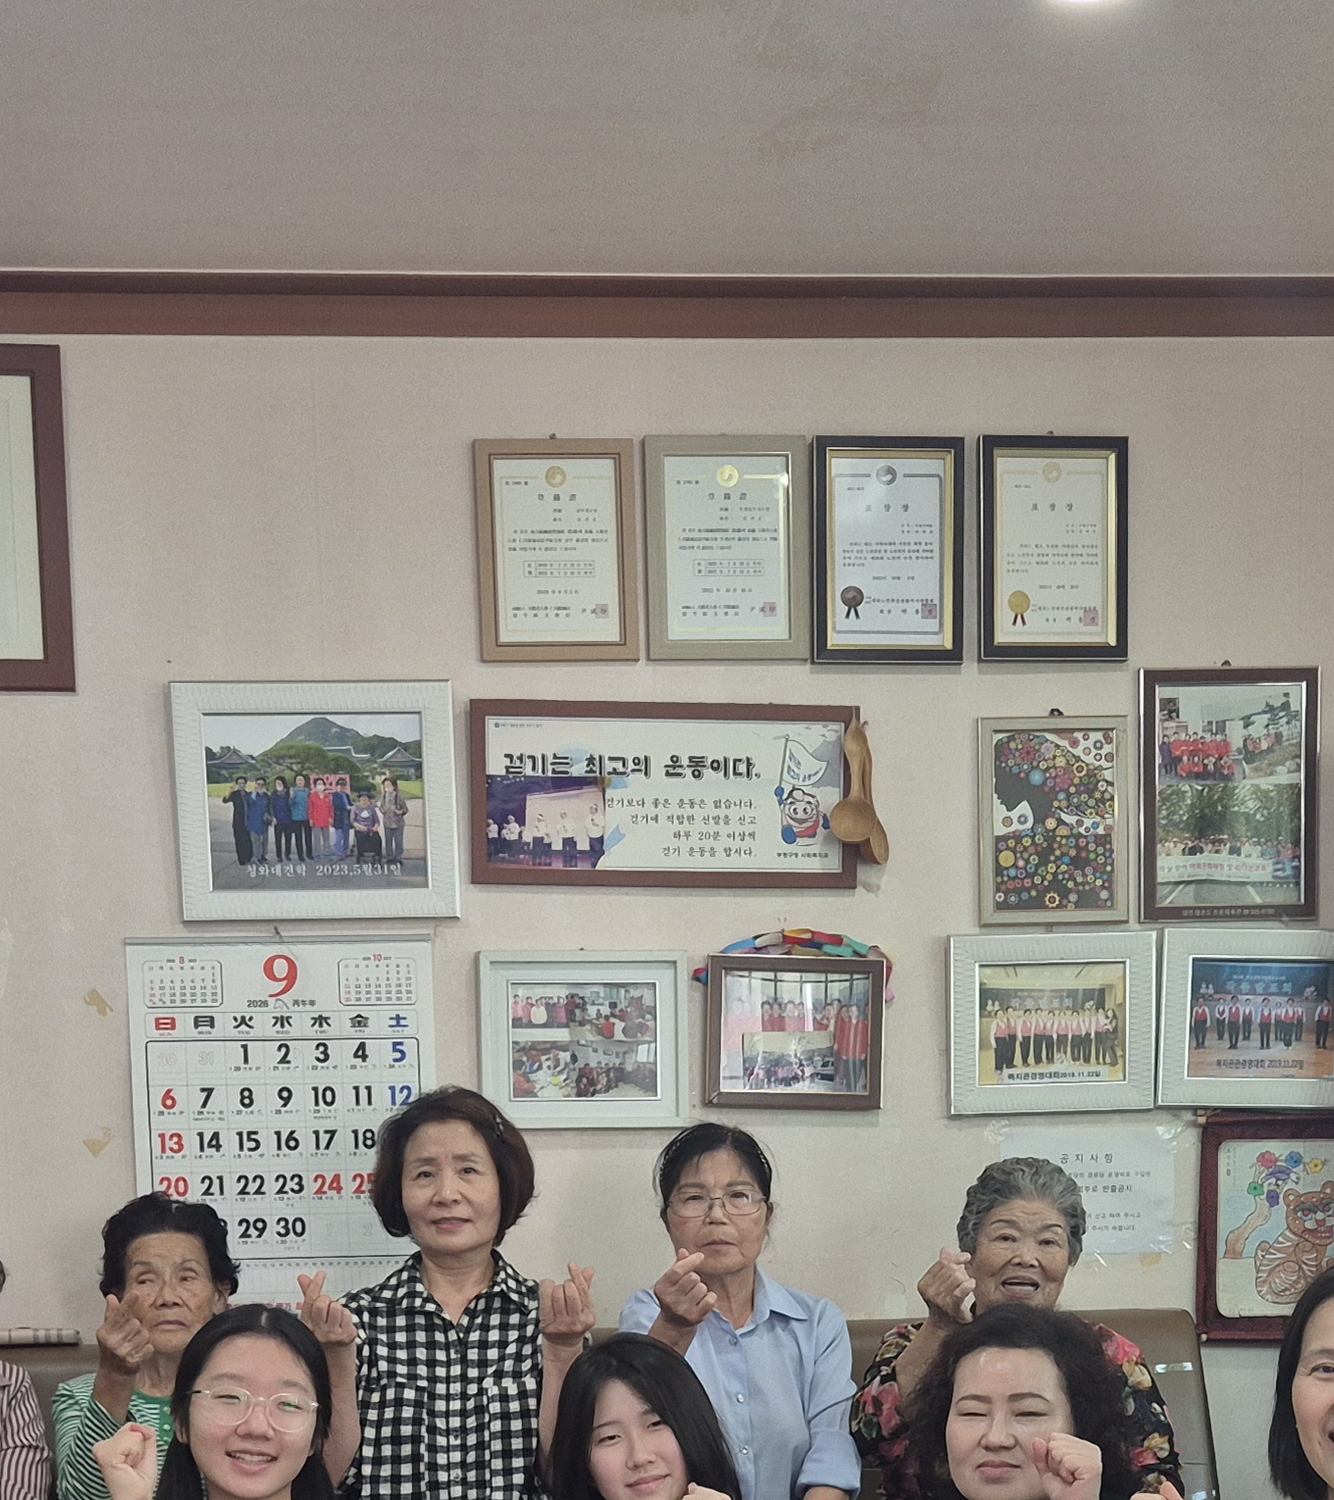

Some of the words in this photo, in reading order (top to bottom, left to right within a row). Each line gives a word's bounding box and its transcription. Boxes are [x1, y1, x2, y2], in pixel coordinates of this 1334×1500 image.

[503, 752, 572, 776] 걷기는
[585, 754, 651, 779] 최고의
[663, 755, 761, 780] 운동이다.
[605, 798, 646, 809] 걷기보다
[677, 798, 707, 810] 운동은
[665, 814, 696, 826] 적합한
[372, 953, 383, 962] 10
[262, 954, 298, 998] 9
[154, 1016, 177, 1031] 日
[193, 1015, 215, 1030] 月
[232, 1015, 255, 1030] 火
[271, 1015, 293, 1029] 水
[310, 1014, 332, 1029] 木
[348, 1013, 370, 1028] 金
[387, 1013, 409, 1028] 土
[240, 1043, 249, 1065] 1
[276, 1043, 292, 1065] 2
[314, 1042, 331, 1064] 3
[353, 1041, 369, 1063] 4
[391, 1041, 407, 1063] 5
[161, 1088, 178, 1110] 6
[199, 1087, 215, 1109] 7
[239, 1087, 255, 1109] 8
[277, 1086, 293, 1108] 9
[311, 1086, 336, 1107] 10
[352, 1085, 373, 1107] 11
[387, 1085, 413, 1107] 12
[157, 1132, 185, 1155] 13
[196, 1131, 223, 1153] 14
[235, 1130, 261, 1153] 15
[273, 1129, 300, 1152] 16
[312, 1129, 339, 1151] 17
[351, 1128, 377, 1150] 18
[158, 1176, 190, 1198] 20
[200, 1175, 225, 1197] 21
[236, 1174, 267, 1196] 22
[274, 1173, 305, 1195] 23
[312, 1173, 344, 1195] 24
[237, 1217, 268, 1240] 29
[275, 1217, 306, 1238] 30
